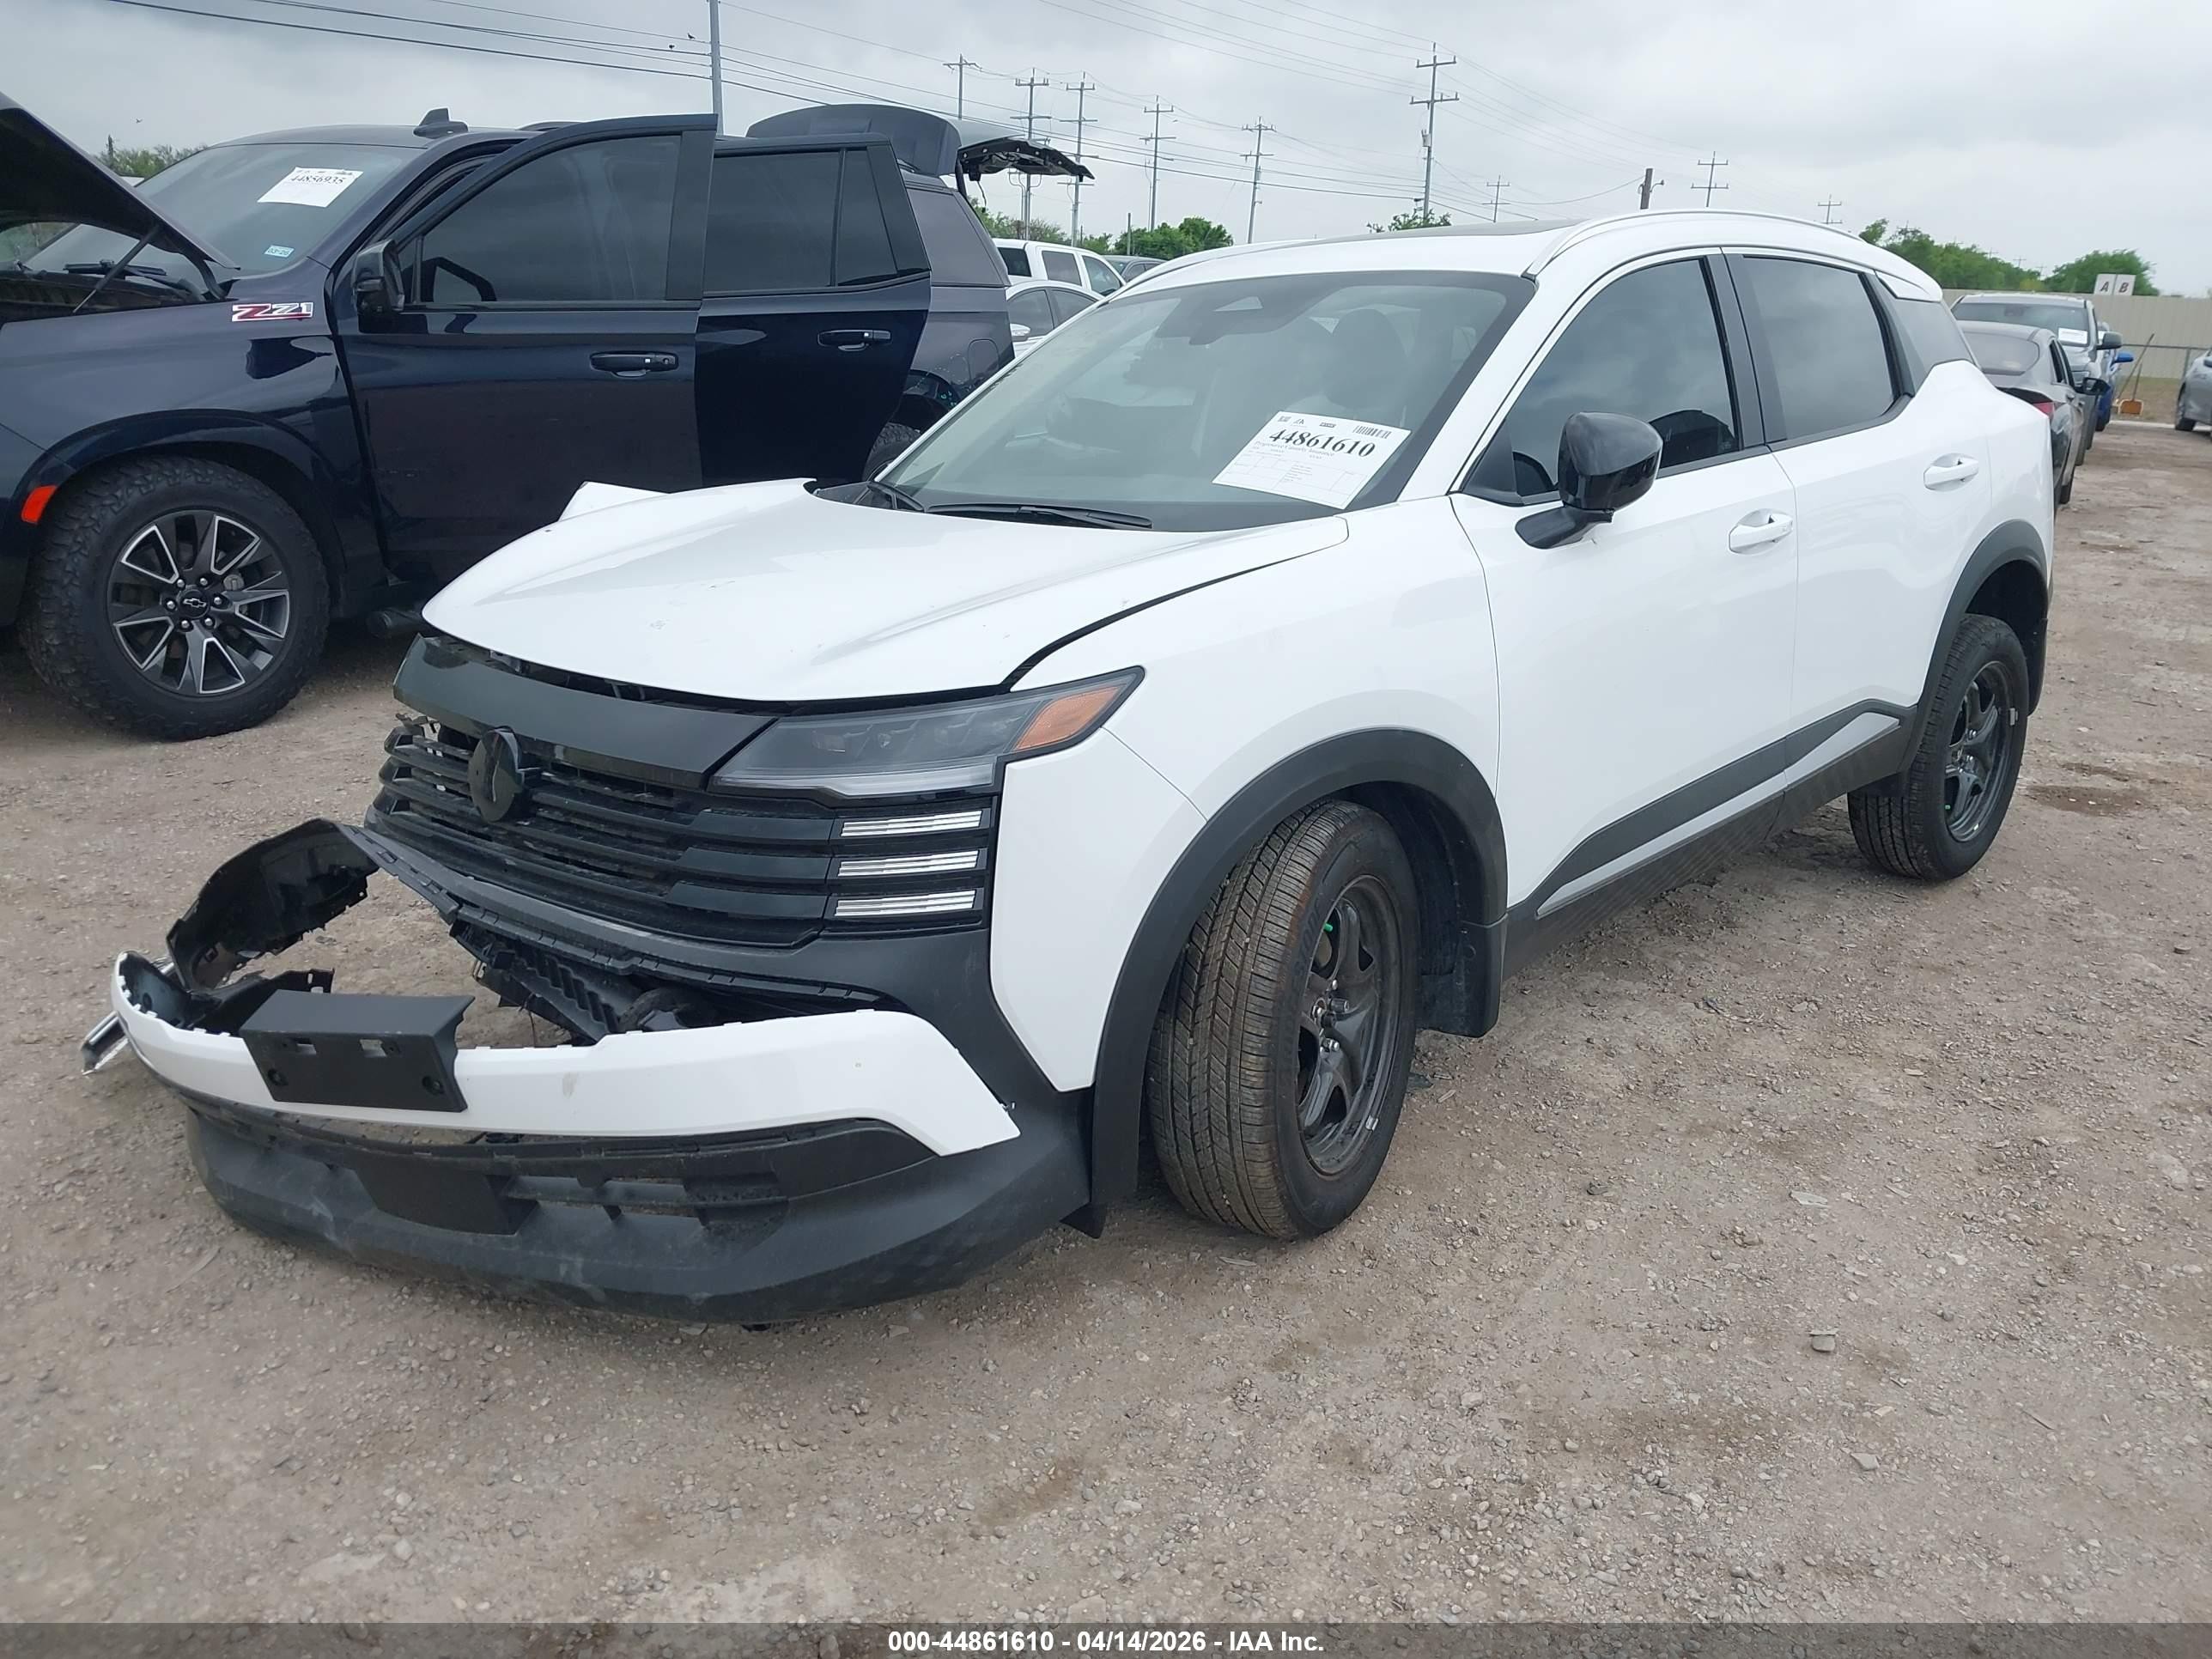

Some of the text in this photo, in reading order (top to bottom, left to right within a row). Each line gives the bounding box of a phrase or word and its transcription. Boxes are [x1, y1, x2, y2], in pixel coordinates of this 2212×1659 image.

[2100, 281, 2110, 292] A
[2118, 282, 2130, 293] B
[1269, 428, 1376, 458] 44861610
